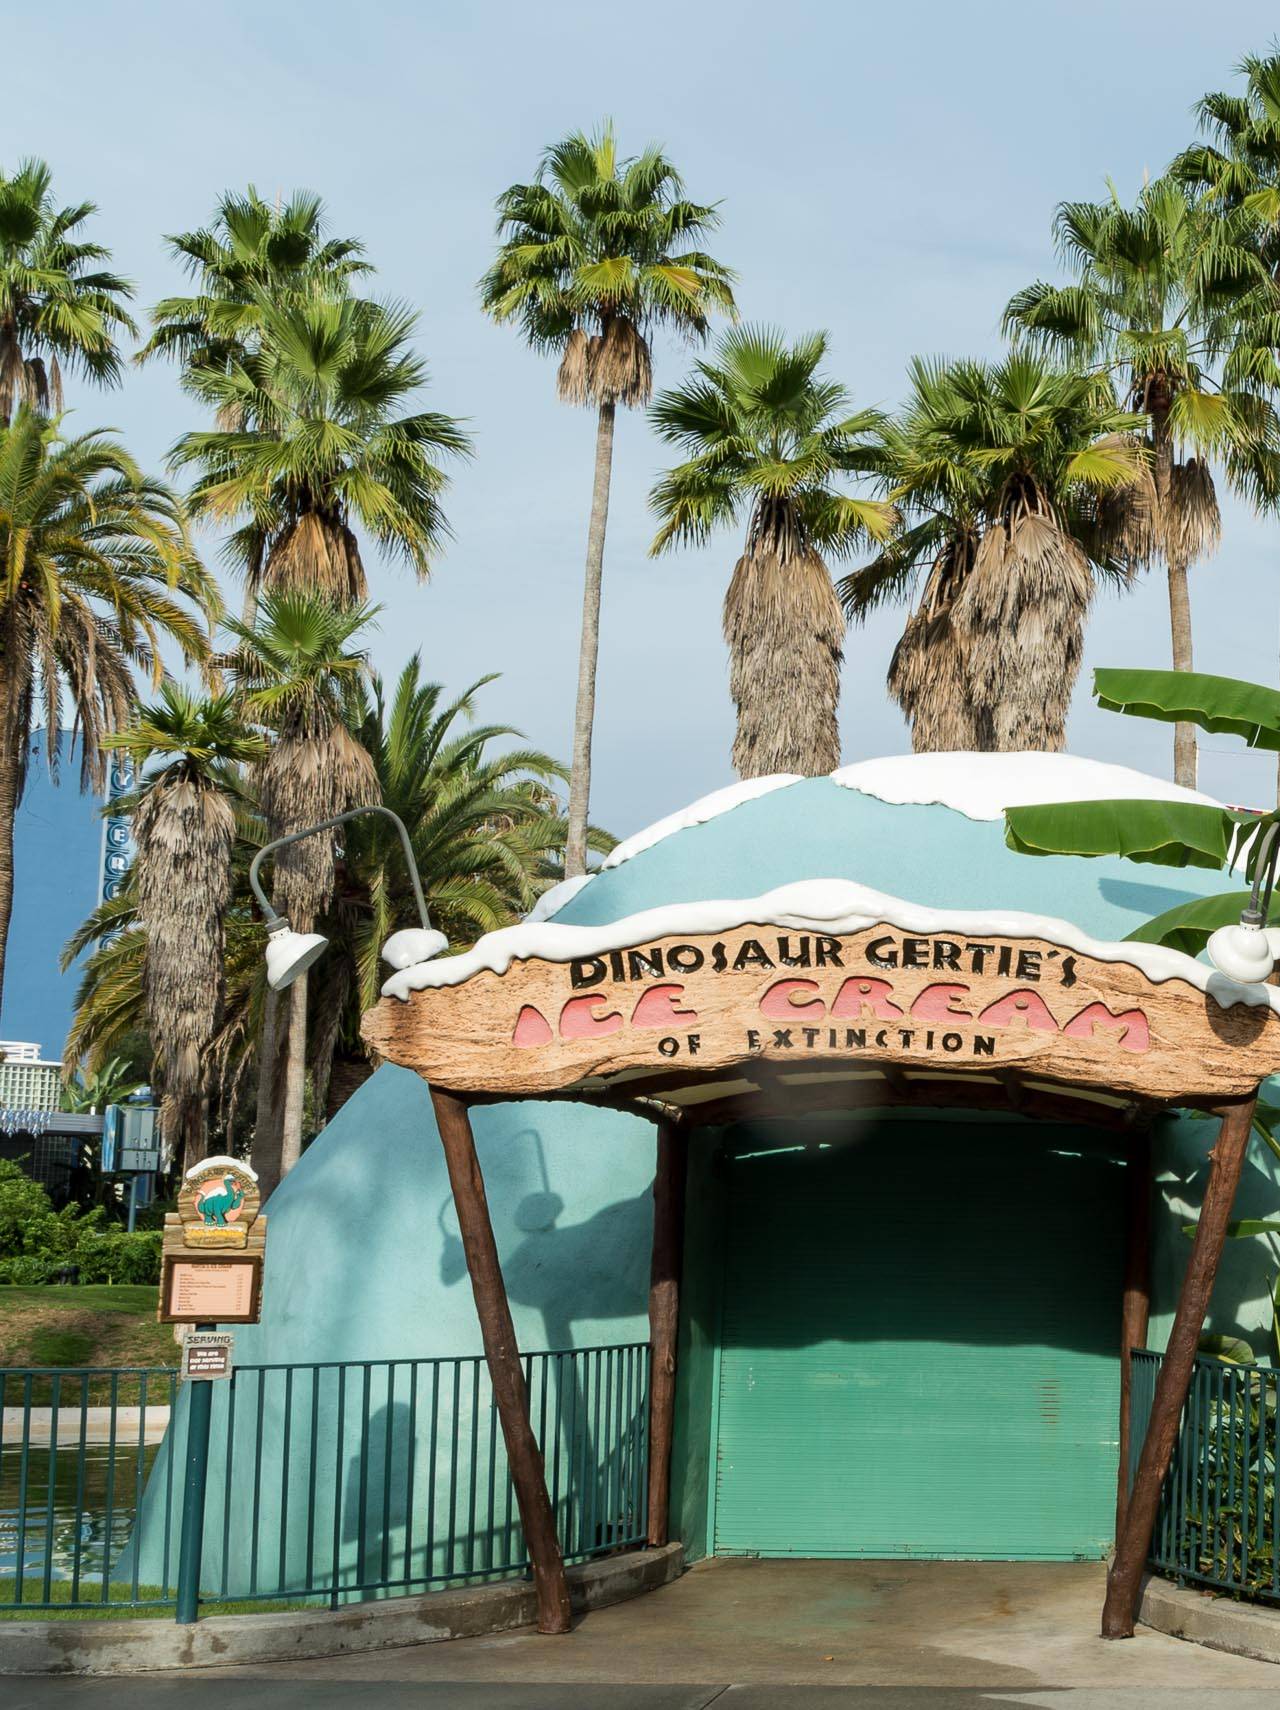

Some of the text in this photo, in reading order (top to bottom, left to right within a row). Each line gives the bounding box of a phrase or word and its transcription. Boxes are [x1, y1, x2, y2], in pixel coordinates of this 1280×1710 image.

[570, 934, 1078, 990] DINOSAUR GERTIE'S
[511, 975, 1150, 1055] ICE CREAM
[658, 1027, 996, 1058] OF EXTINCTION
[187, 1335, 231, 1345] SERVING
